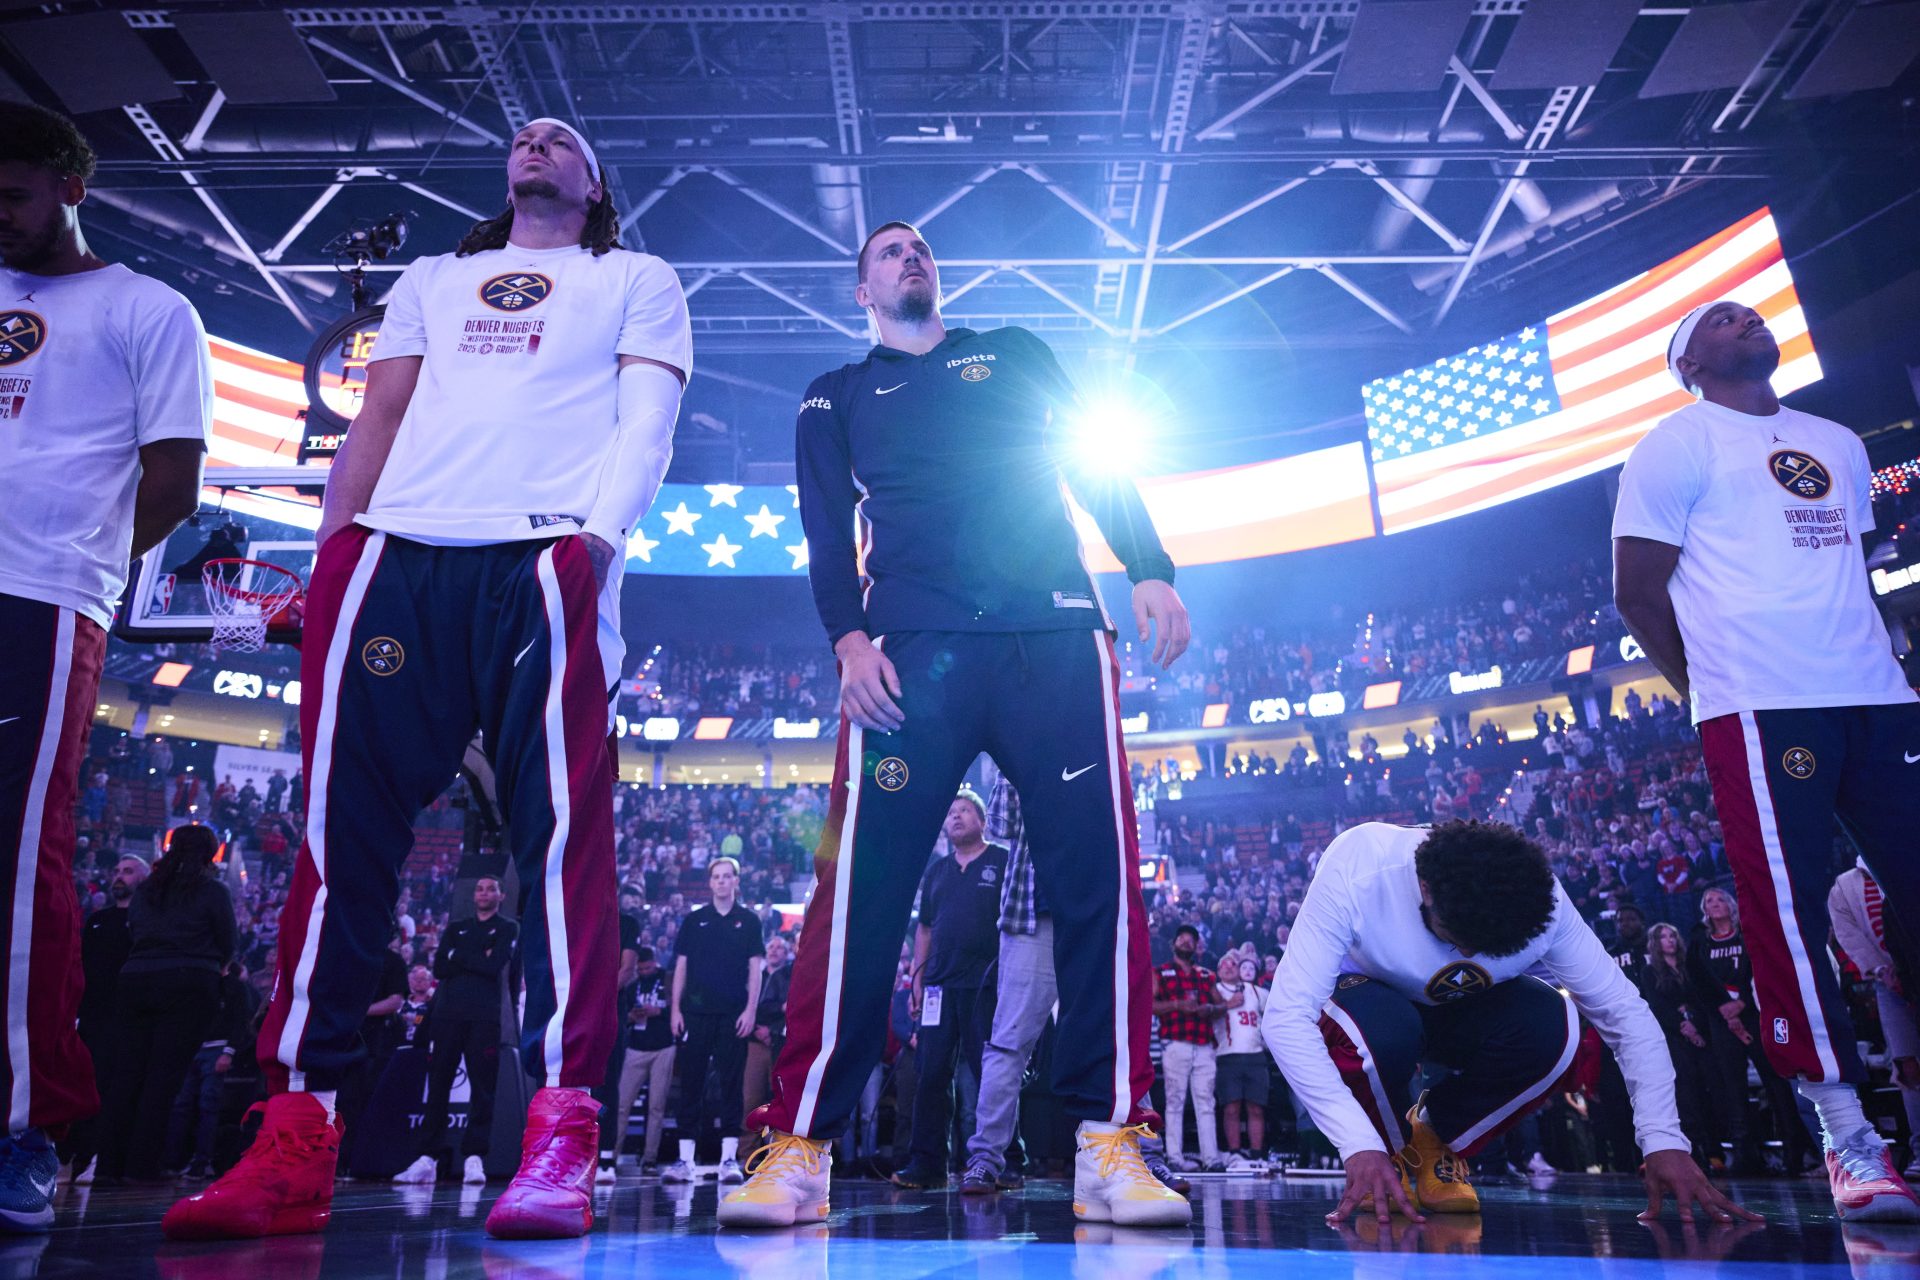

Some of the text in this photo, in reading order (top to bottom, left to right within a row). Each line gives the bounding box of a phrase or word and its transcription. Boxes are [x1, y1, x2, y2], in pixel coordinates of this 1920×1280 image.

[464, 319, 545, 333] DENVER NUGGETS
[467, 334, 492, 343] WESTERN
[457, 343, 476, 354] 2025
[495, 344, 518, 354] GROUP
[1784, 509, 1815, 523] DENVER
[1794, 524, 1844, 535] WESTERN CONFERENCE
[1792, 536, 1809, 548] 2025
[1821, 535, 1843, 547] GROUP
[1731, 956, 1739, 969] 7
[1238, 1010, 1258, 1028] 32
